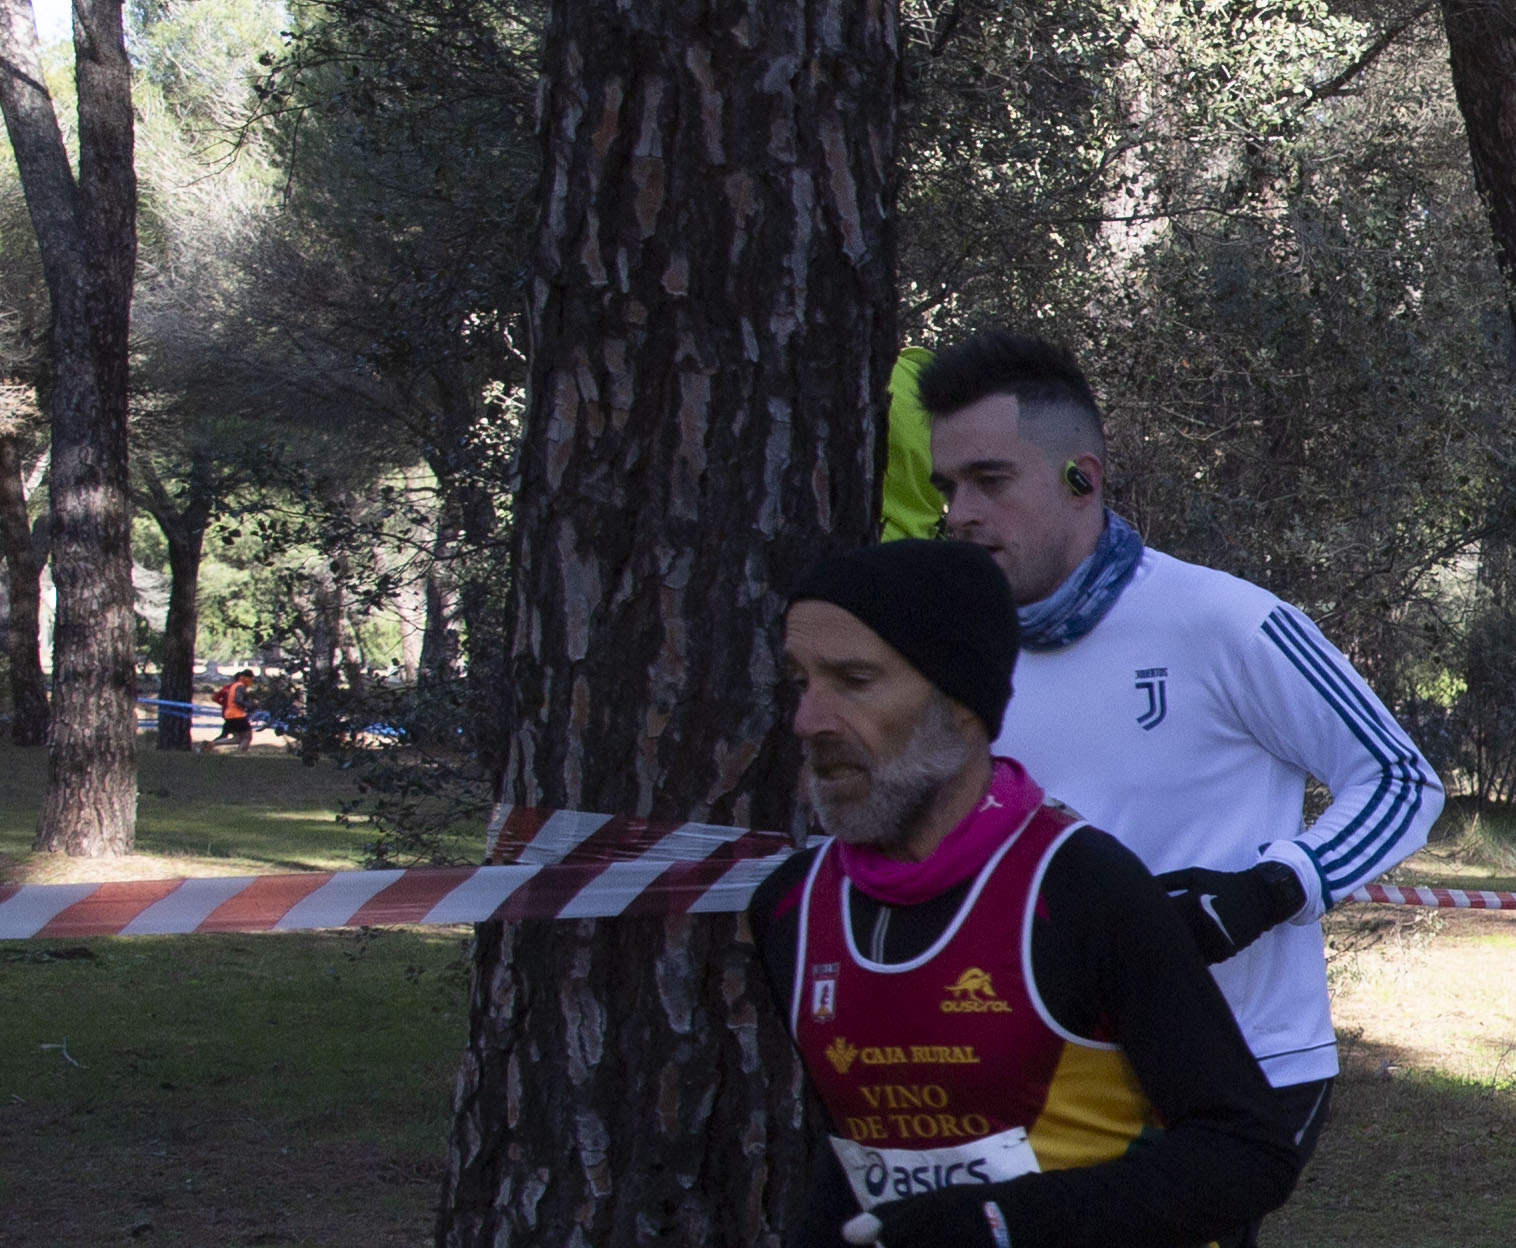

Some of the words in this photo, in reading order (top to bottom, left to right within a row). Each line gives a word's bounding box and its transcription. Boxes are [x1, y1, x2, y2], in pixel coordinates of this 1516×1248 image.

[861, 1046, 908, 1064] CAJA
[911, 1046, 981, 1064] RURAL
[859, 1084, 949, 1109] VINO
[848, 1115, 888, 1140] DE
[891, 1113, 990, 1138] TORO
